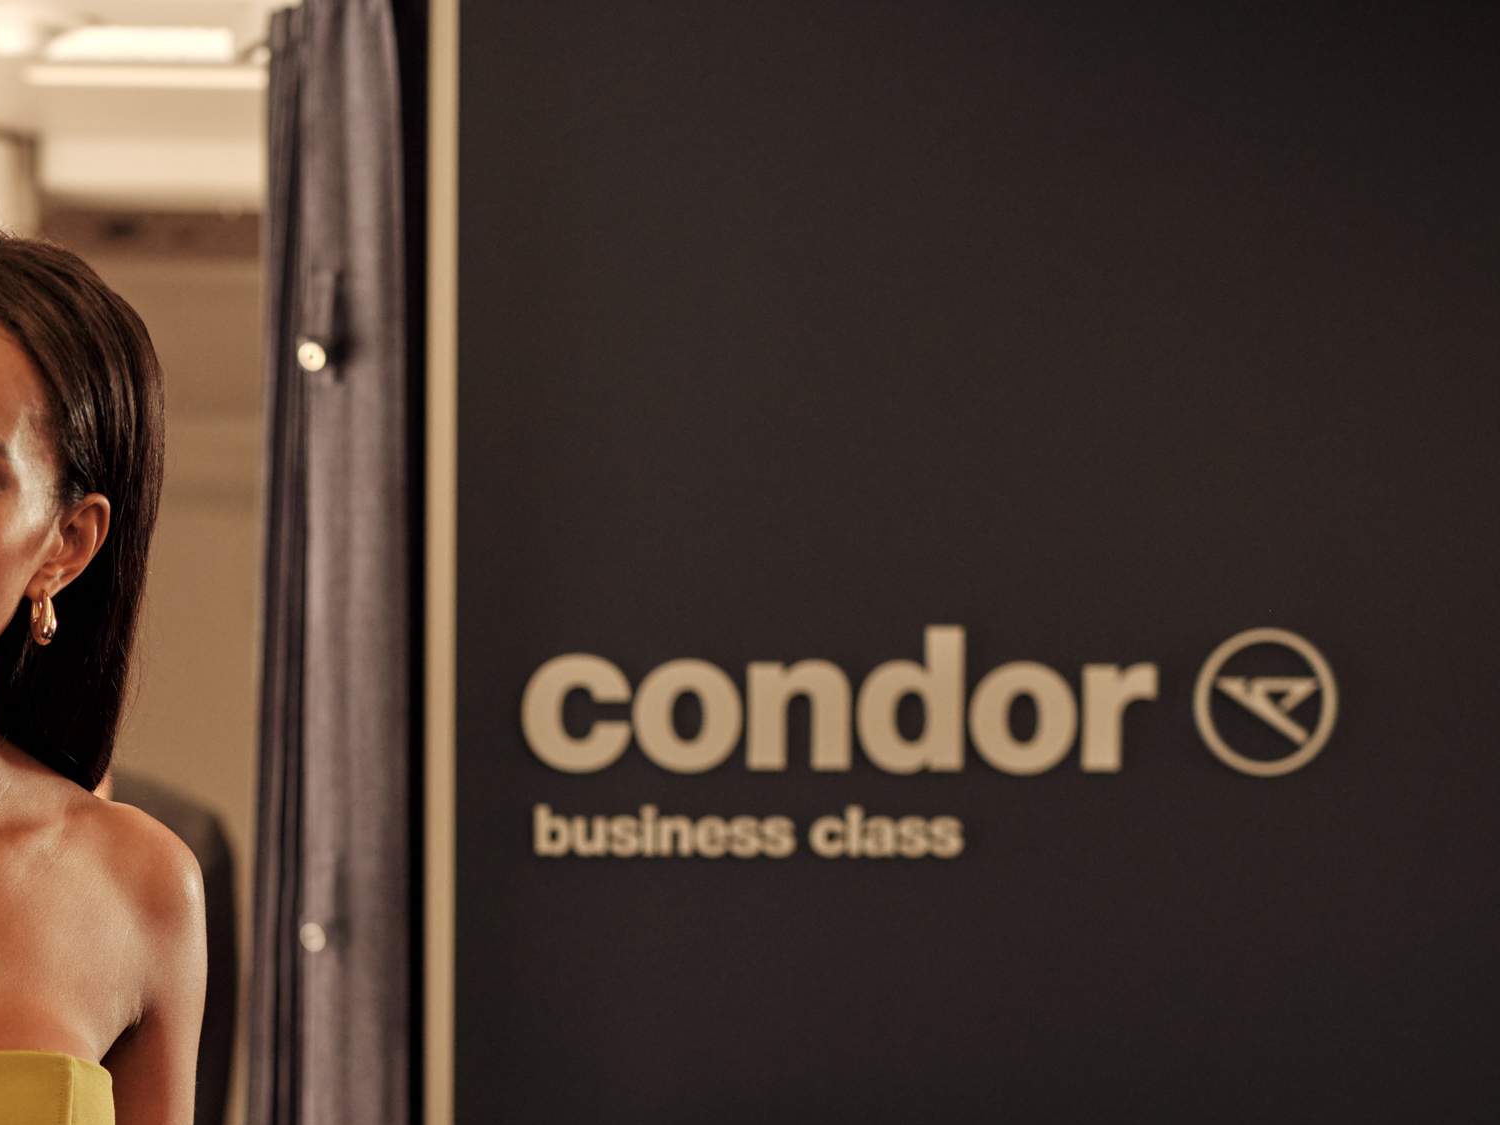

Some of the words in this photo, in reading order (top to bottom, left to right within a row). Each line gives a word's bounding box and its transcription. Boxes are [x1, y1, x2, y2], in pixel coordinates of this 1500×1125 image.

[523, 626, 1157, 774] condor
[535, 805, 795, 856] business
[810, 806, 962, 856] class
